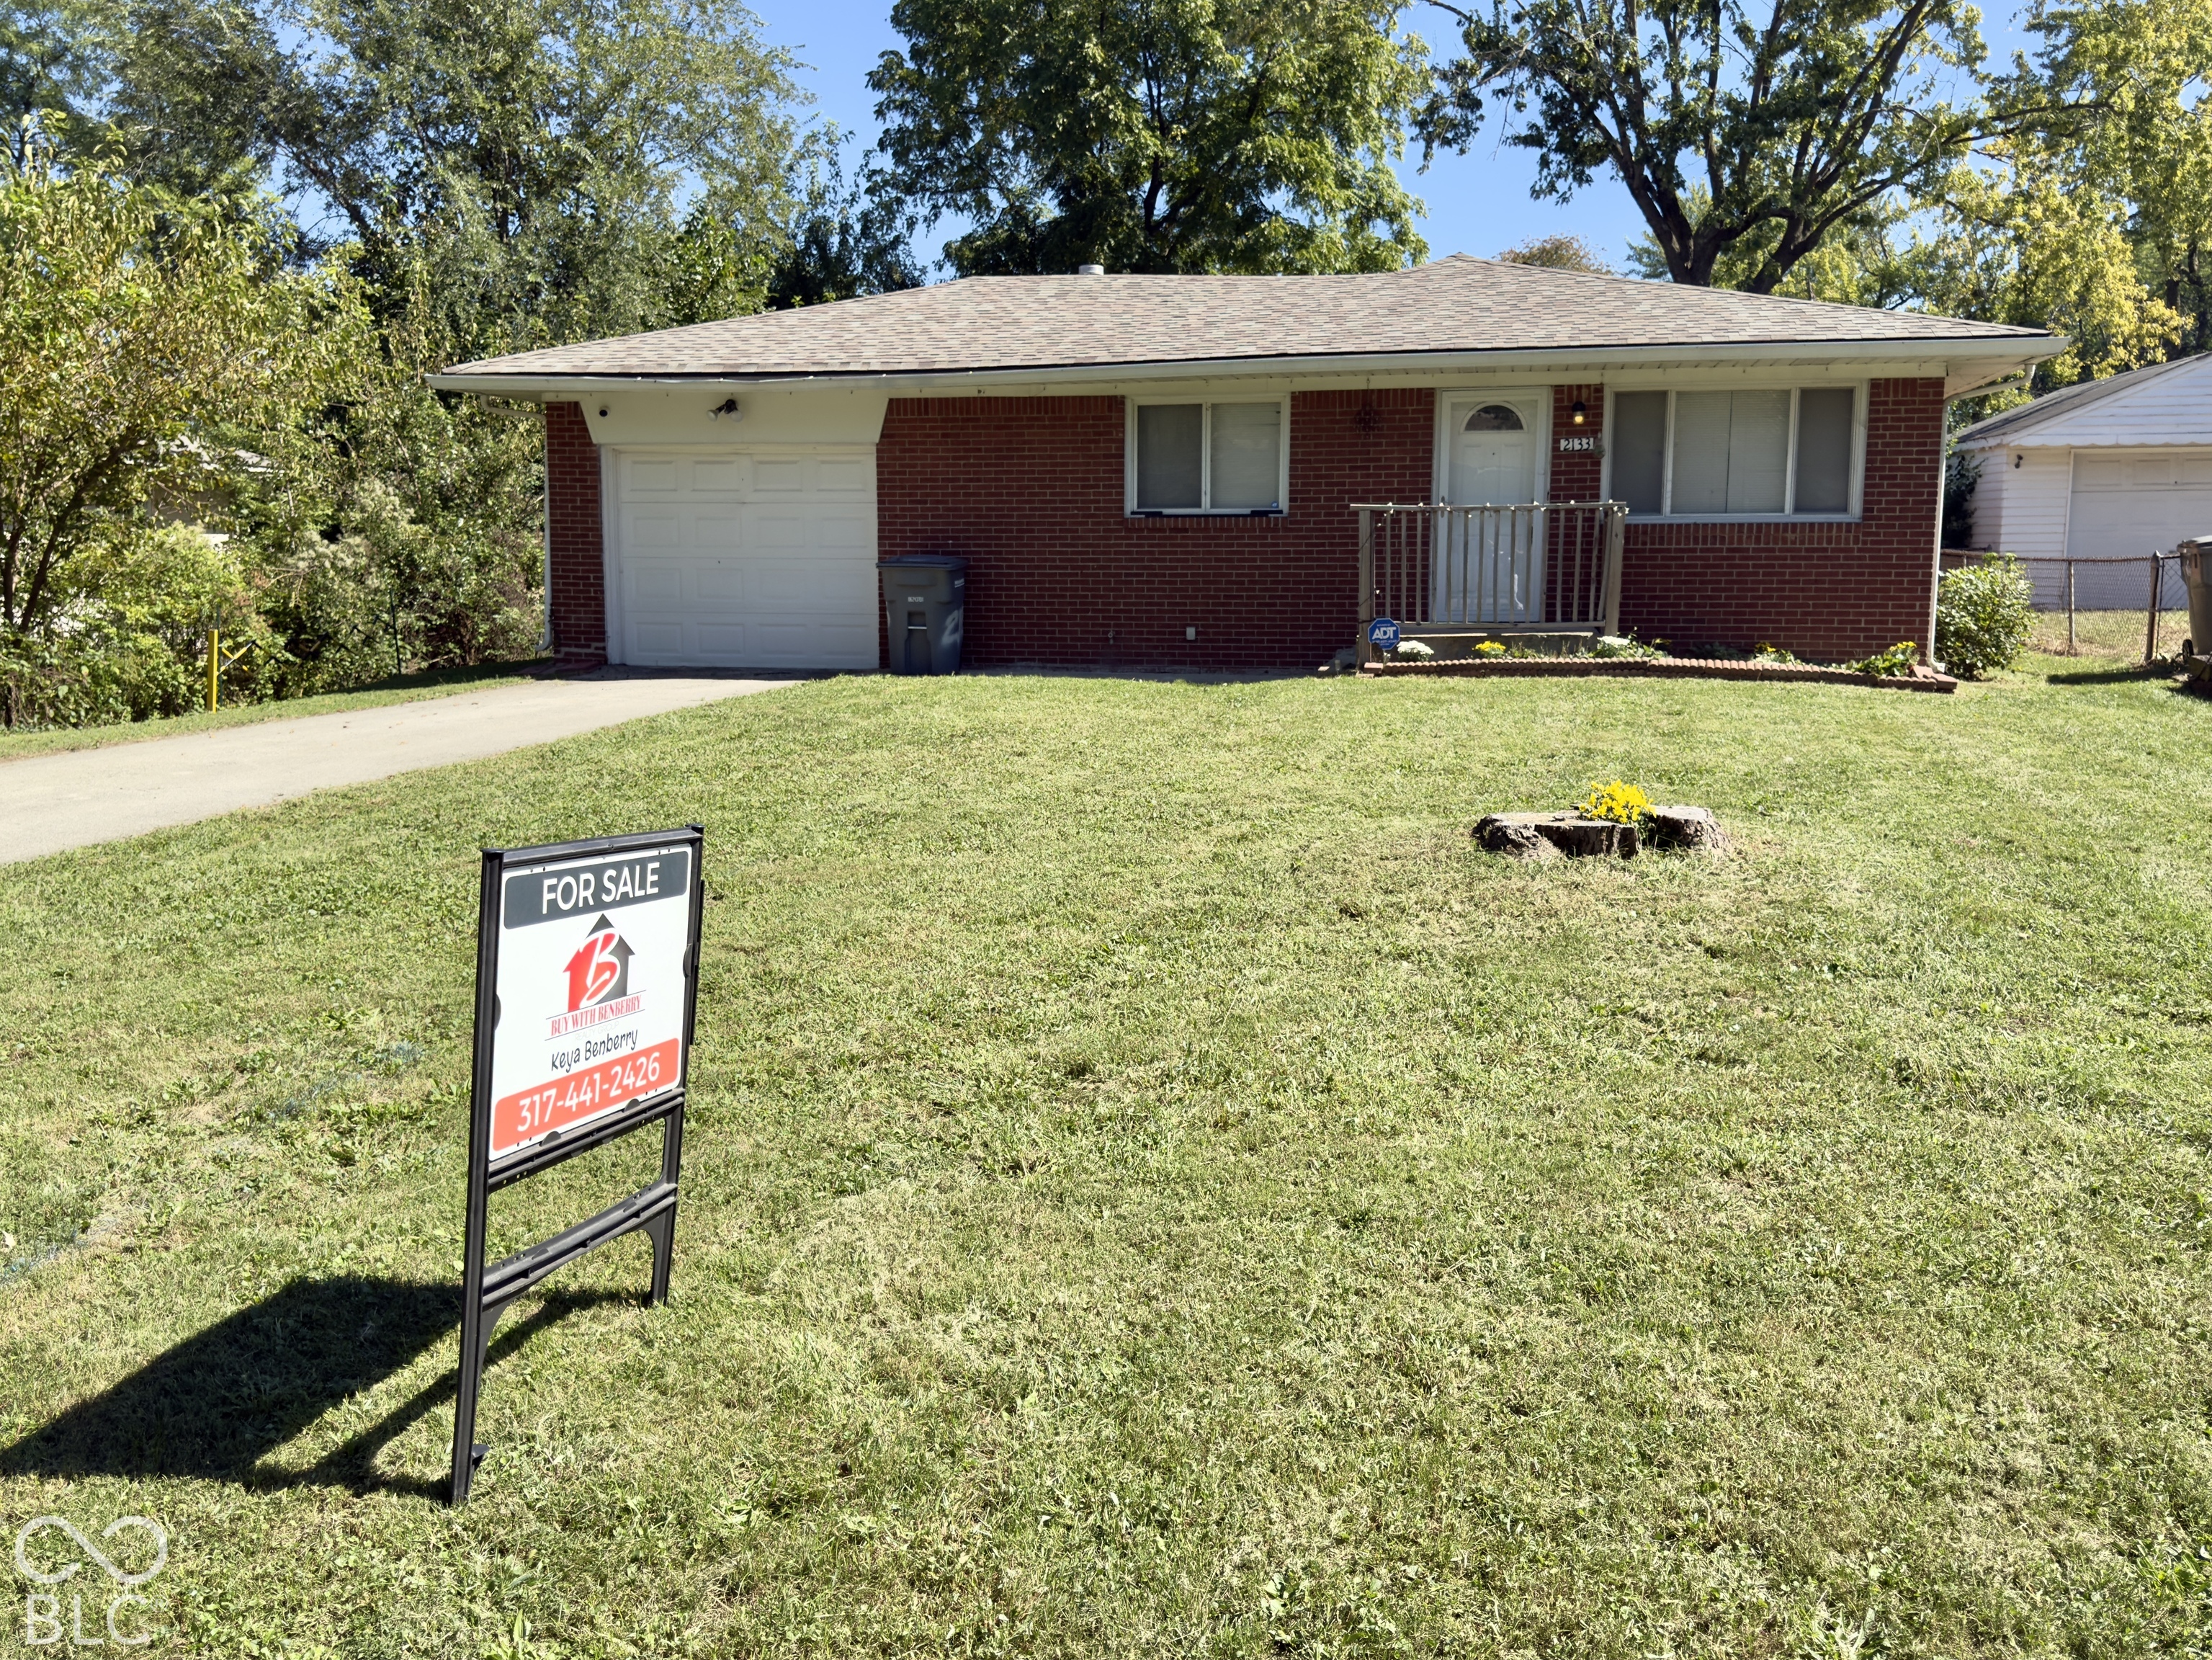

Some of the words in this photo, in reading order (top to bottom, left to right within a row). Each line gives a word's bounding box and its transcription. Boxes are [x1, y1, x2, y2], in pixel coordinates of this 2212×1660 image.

[1563, 437, 1591, 452] 2133
[1371, 627, 1397, 640] ADT
[542, 873, 595, 914] FOR
[601, 862, 660, 903] SALE
[551, 1015, 570, 1036] BUY
[571, 1008, 596, 1030] WITH
[598, 994, 642, 1022] BENBERRY
[597, 1020, 619, 1035] GROUP
[551, 1048, 581, 1074] Keya
[585, 1029, 638, 1061] Benberry
[517, 1052, 660, 1132] 317-441-2426
